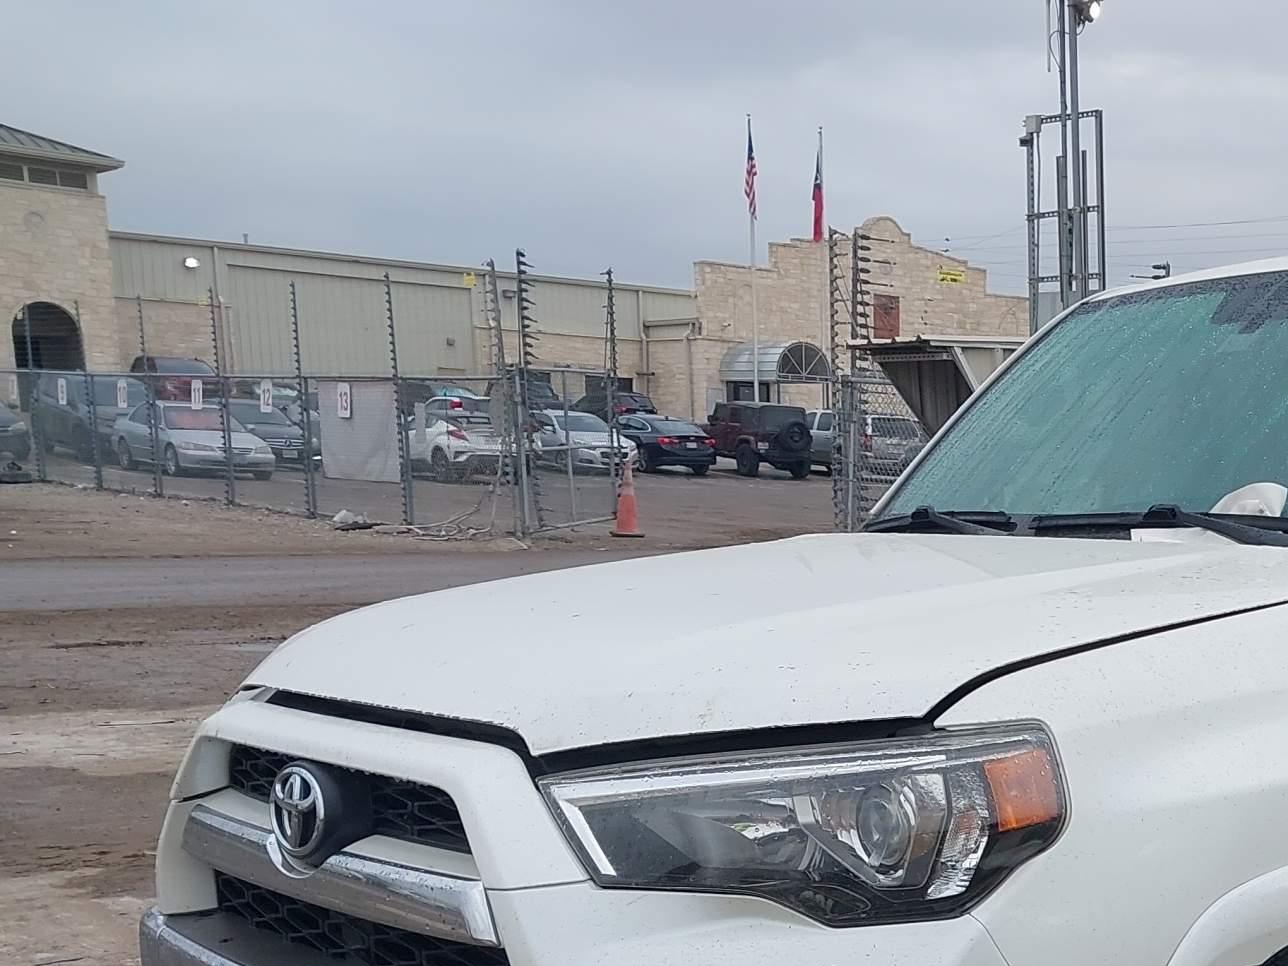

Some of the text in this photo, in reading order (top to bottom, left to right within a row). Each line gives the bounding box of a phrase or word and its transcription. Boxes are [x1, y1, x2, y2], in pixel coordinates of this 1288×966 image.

[192, 387, 202, 403] 11
[261, 389, 271, 406] 12
[338, 391, 349, 412] 13
